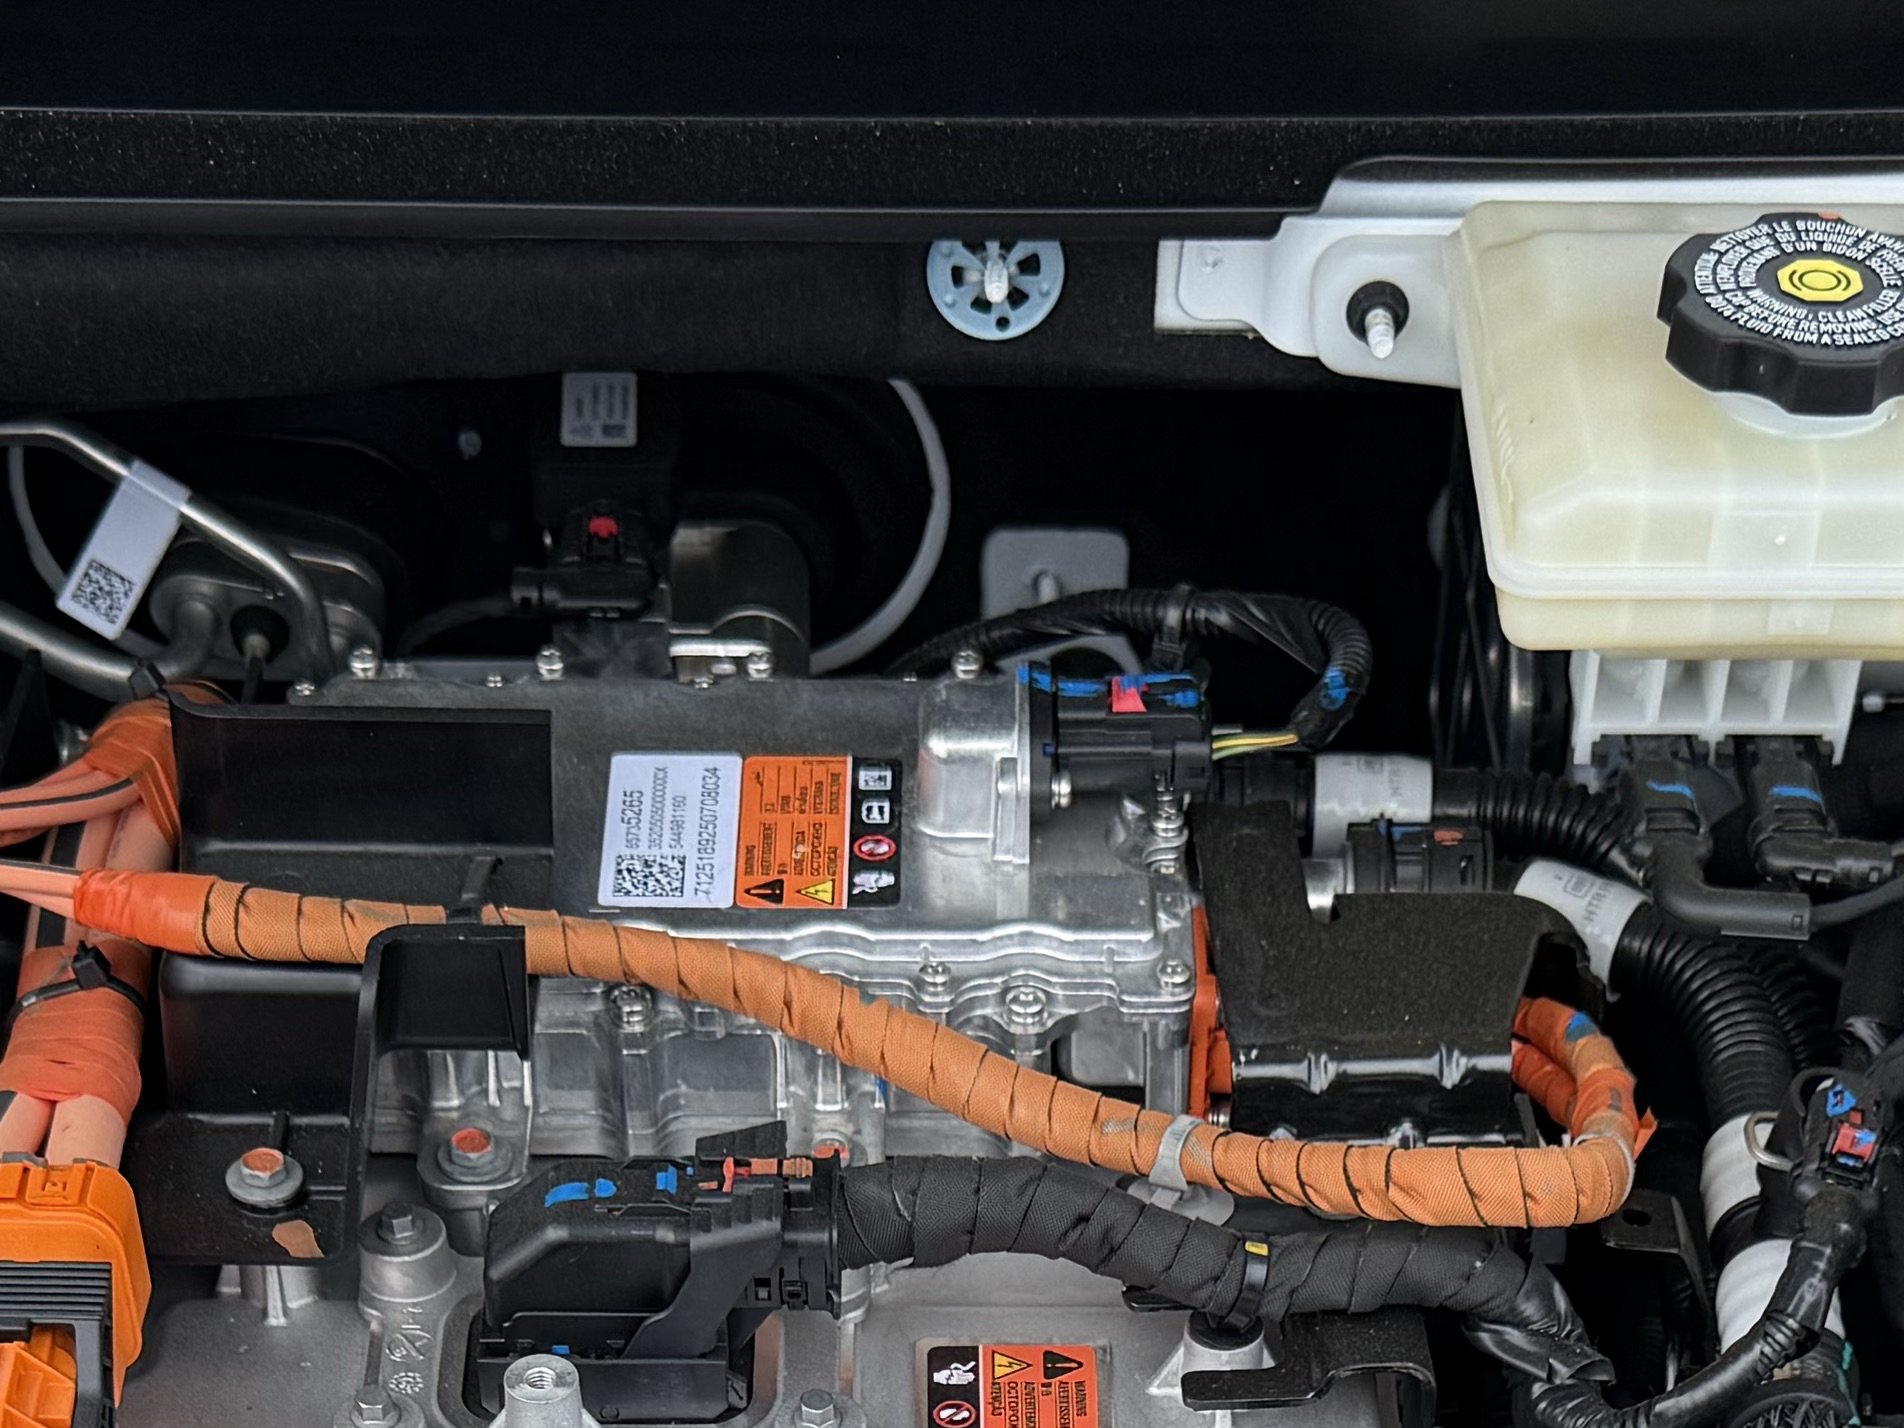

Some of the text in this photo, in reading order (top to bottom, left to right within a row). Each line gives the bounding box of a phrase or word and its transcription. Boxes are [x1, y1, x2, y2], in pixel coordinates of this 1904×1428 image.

[1772, 220, 1793, 232] LE
[1795, 220, 1867, 239] BOUCHON
[1774, 231, 1796, 243] DU
[1800, 231, 1857, 246] LIQUIDE
[1858, 240, 1881, 253] DE
[1780, 242, 1817, 253] D'UN
[1822, 242, 1869, 261] BIDON
[1818, 308, 1867, 322] CLEAN
[1729, 311, 1775, 335] FLUID
[1772, 326, 1819, 344] FROM
[1819, 334, 1832, 345] A
[1833, 328, 1891, 346] SEALED
